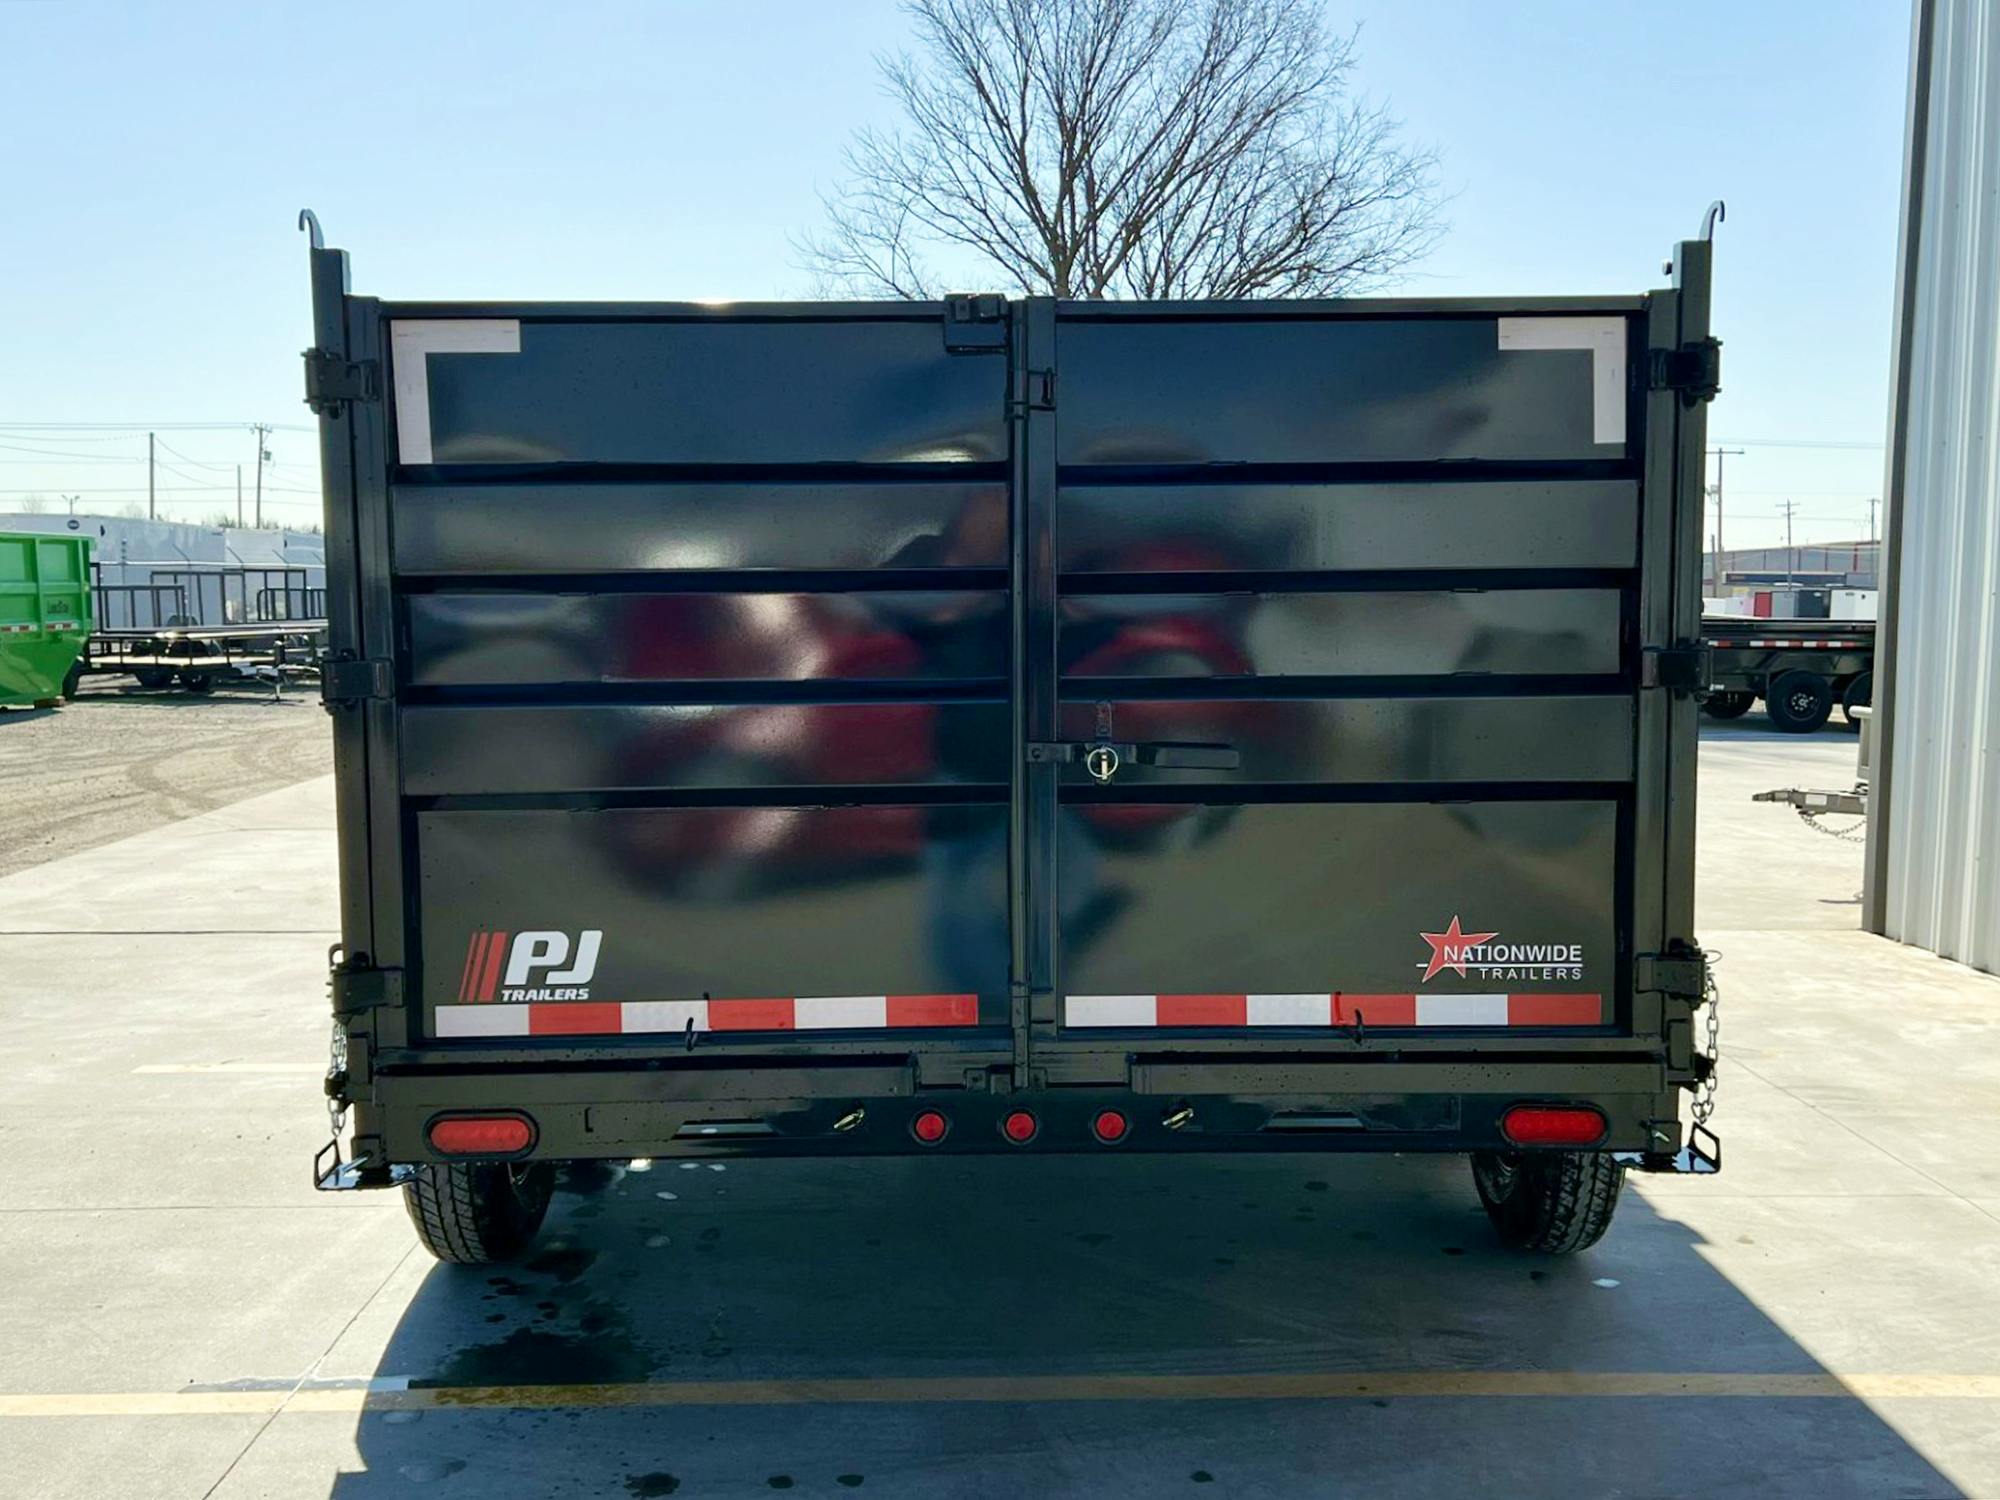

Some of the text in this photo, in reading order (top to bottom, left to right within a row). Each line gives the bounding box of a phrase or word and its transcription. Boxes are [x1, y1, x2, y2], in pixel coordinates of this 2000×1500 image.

[504, 930, 603, 985] PJ
[1443, 945, 1582, 961] NATIONWIDE
[1480, 968, 1582, 980] TRAILERS
[501, 988, 590, 1001] TRAILERS
